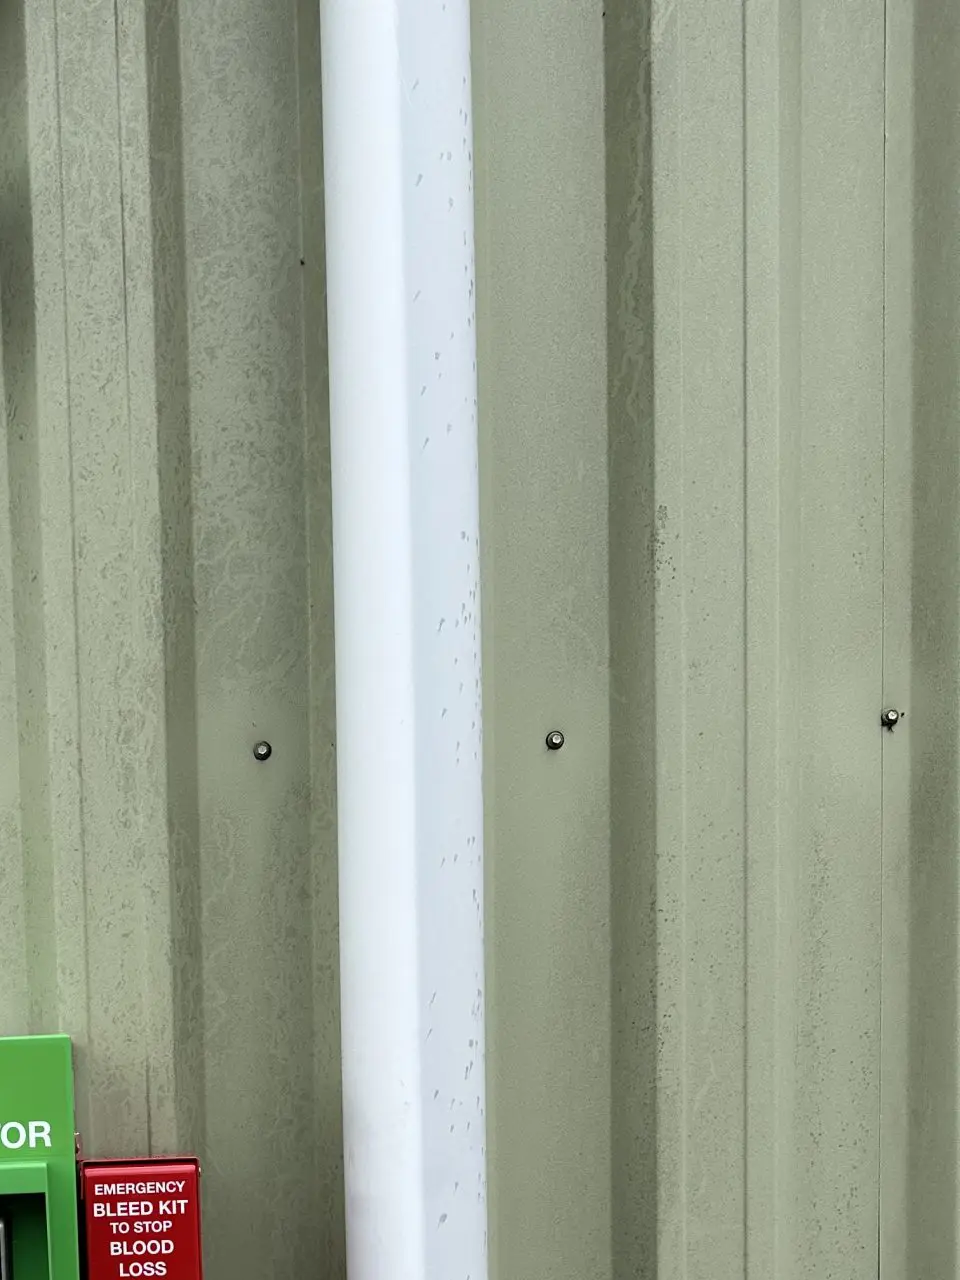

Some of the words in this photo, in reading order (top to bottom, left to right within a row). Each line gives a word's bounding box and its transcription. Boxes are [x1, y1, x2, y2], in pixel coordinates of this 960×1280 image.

[94, 1180, 185, 1196] EMERGENCY
[93, 1201, 153, 1217] BLEED
[159, 1199, 188, 1215] KIT
[110, 1222, 130, 1234] TO
[134, 1220, 172, 1233] STOP
[110, 1239, 174, 1256] BLOOD
[119, 1261, 167, 1277] LOSS
